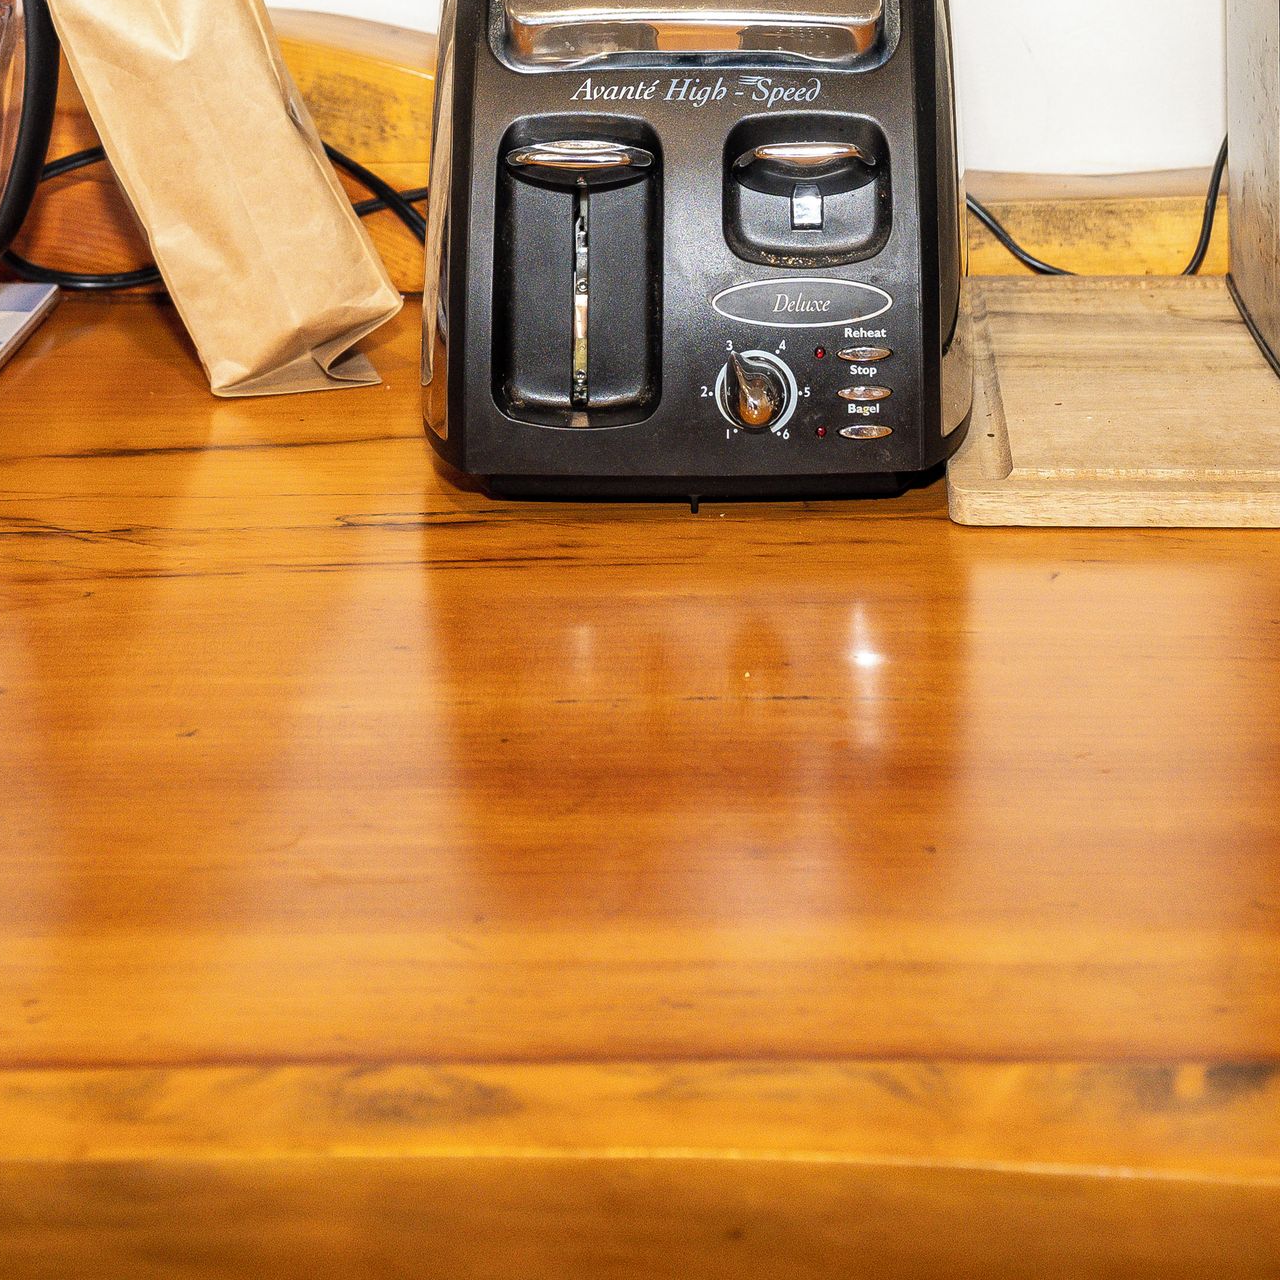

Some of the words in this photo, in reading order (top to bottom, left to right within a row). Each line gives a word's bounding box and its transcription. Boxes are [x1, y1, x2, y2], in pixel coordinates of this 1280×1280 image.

[569, 77, 661, 101] Avanté
[663, 76, 728, 108] High
[751, 76, 822, 108] Speed
[772, 292, 831, 313] Deluxe
[844, 327, 887, 338] Reheat
[726, 340, 733, 351] 3
[778, 339, 786, 350] 4
[849, 364, 878, 377] Stop
[700, 385, 708, 397] 2
[804, 386, 811, 398] 5
[847, 403, 880, 416] Bagel
[782, 428, 790, 439] 6
